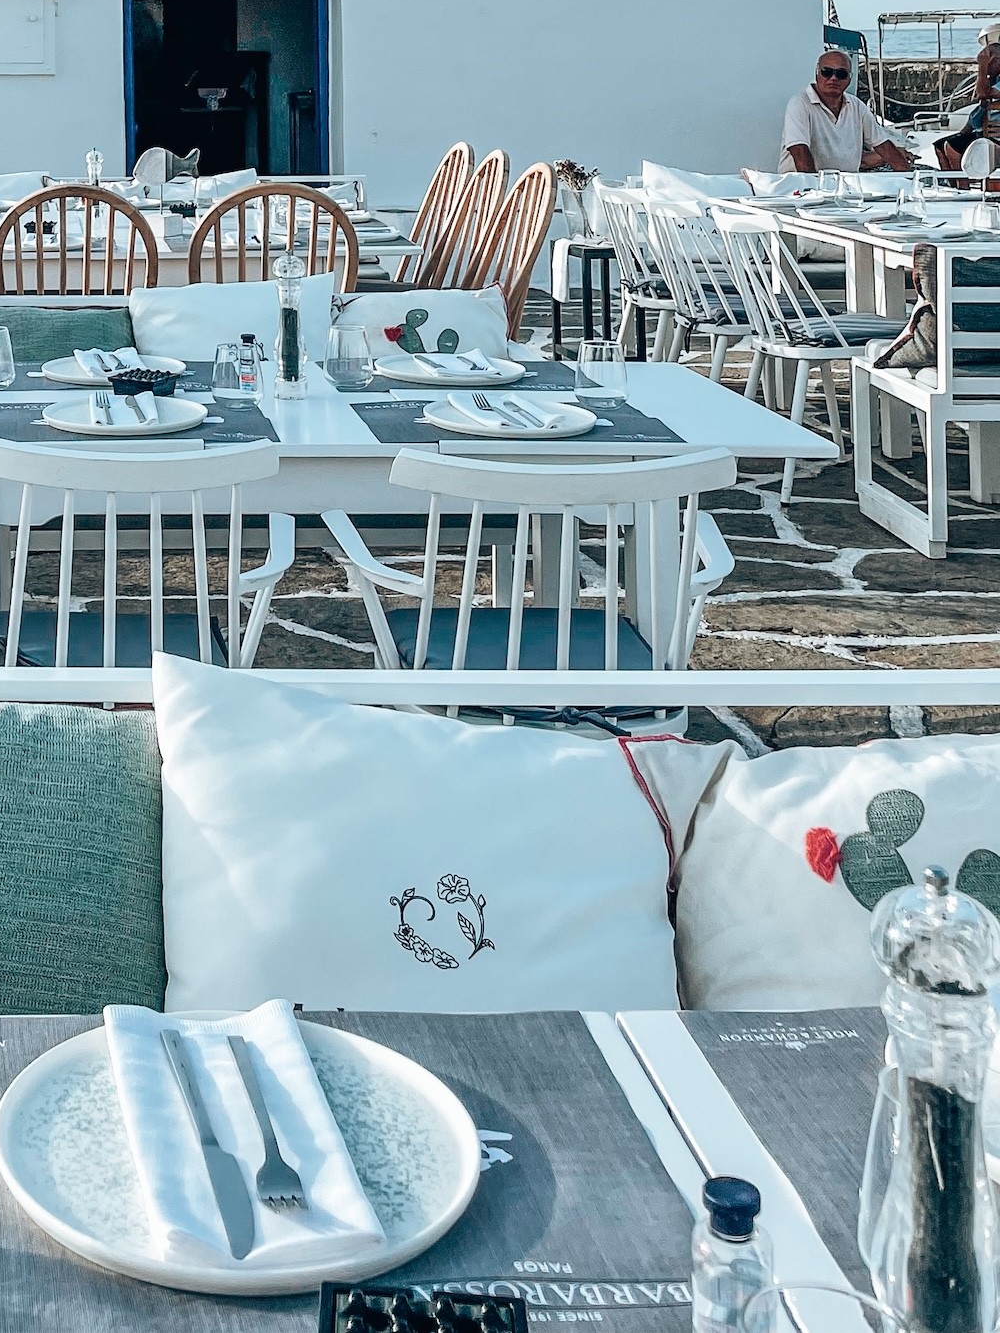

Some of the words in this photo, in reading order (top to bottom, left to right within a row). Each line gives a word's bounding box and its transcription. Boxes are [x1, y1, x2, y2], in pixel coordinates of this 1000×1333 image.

[718, 1032, 798, 1043] CHANDON
[513, 1260, 573, 1274] PAROS
[526, 1310, 551, 1322] 198
[557, 1310, 604, 1322] SINCE
